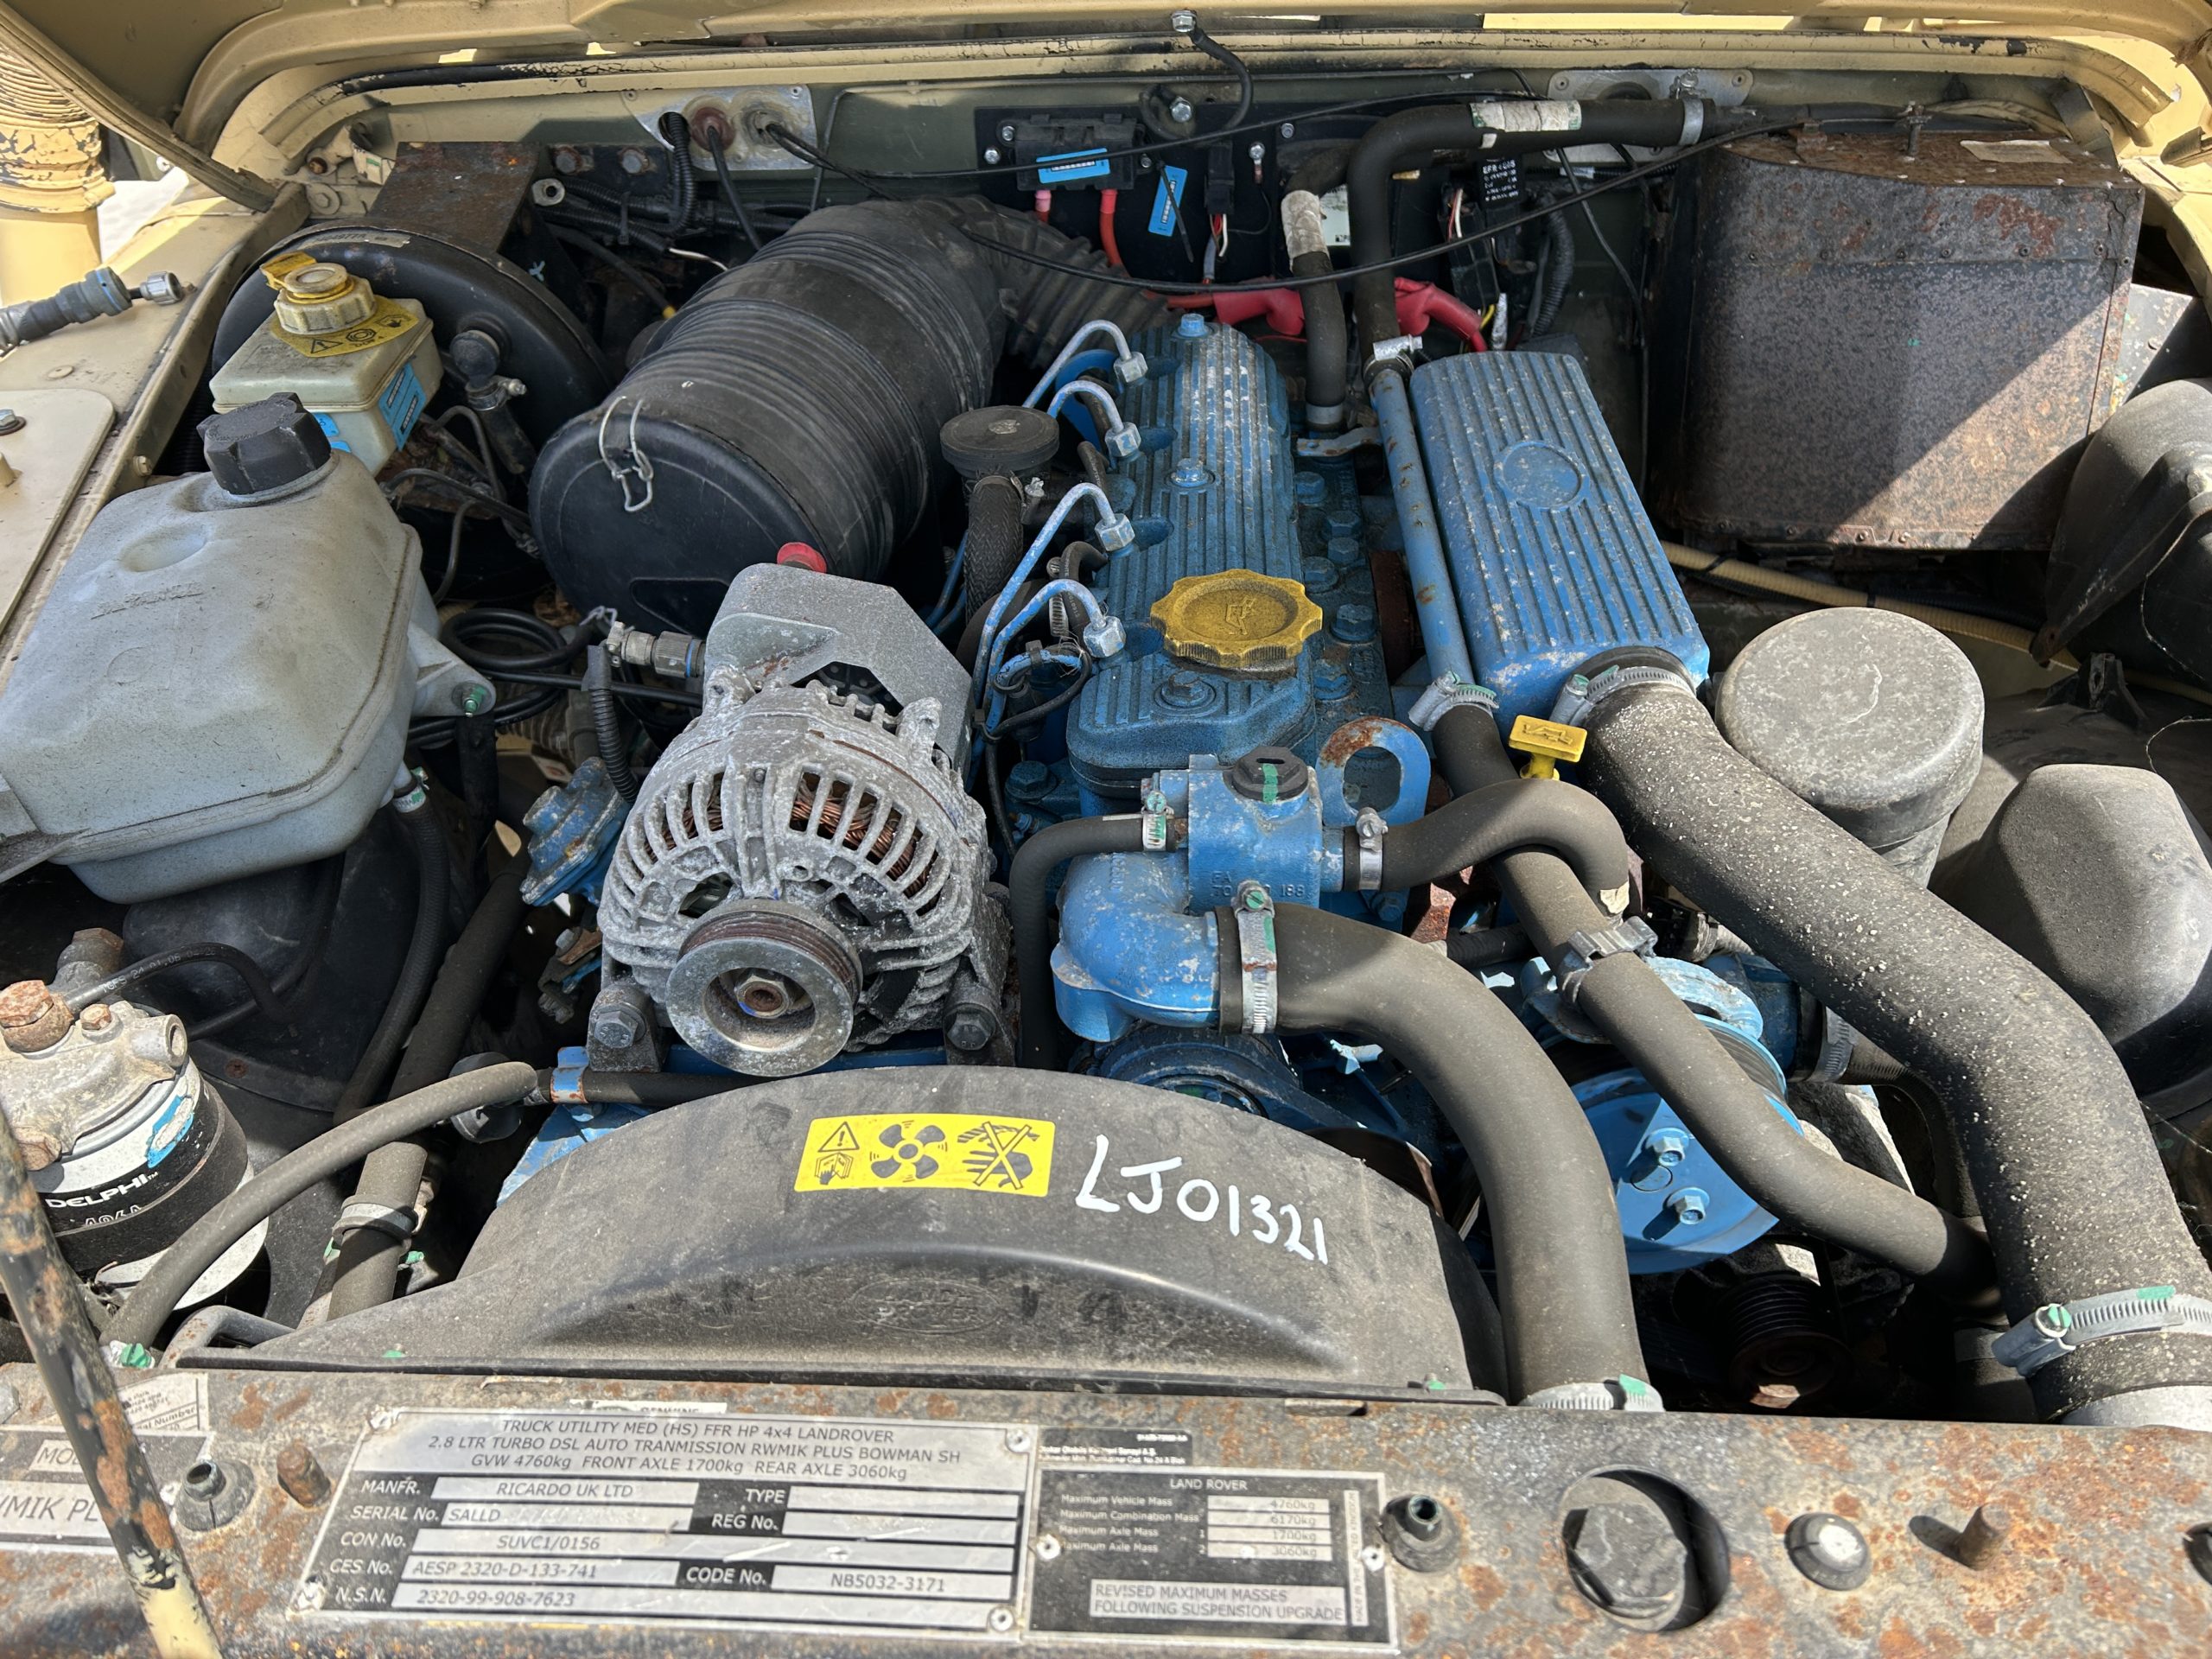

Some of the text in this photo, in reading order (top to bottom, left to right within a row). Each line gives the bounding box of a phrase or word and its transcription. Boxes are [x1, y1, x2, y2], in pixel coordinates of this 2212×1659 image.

[45, 1173, 149, 1208] DELPHI
[1075, 1134, 1328, 1265] LJ01321
[502, 1420, 894, 1443] TRUCK UTILITY MED (HS) FFR HP 4x4 LANDROVER
[428, 1435, 961, 1464] 2.8 LTR TURBO DSL AUTO TRANMISSION RWMIK PLUS BOWMAN SH
[471, 1454, 907, 1482] GVW 4760kg FRONT AXLE 1700kg REAR AXLE 3060kg
[361, 1480, 633, 1497] MANFR. RICARDO UK LTD
[1170, 1478, 1248, 1491] LAND ROVER
[746, 1489, 786, 1504] TYPE
[350, 1505, 501, 1523] SERIAL No. SALLD
[711, 1514, 779, 1532] REG No.
[340, 1532, 601, 1551] CON No. SUVC1/0156
[330, 1560, 598, 1579] CES No. AESP 2320-D-133-741
[686, 1567, 734, 1583] CODE
[739, 1569, 766, 1586] No.
[334, 1587, 576, 1607] N.S.N. 2320-99-908-7623
[1095, 1584, 1287, 1602] REVISED MAXIMUM MASSES
[1095, 1601, 1345, 1621] FOLLOWING SUSPENSION UPGRADE
